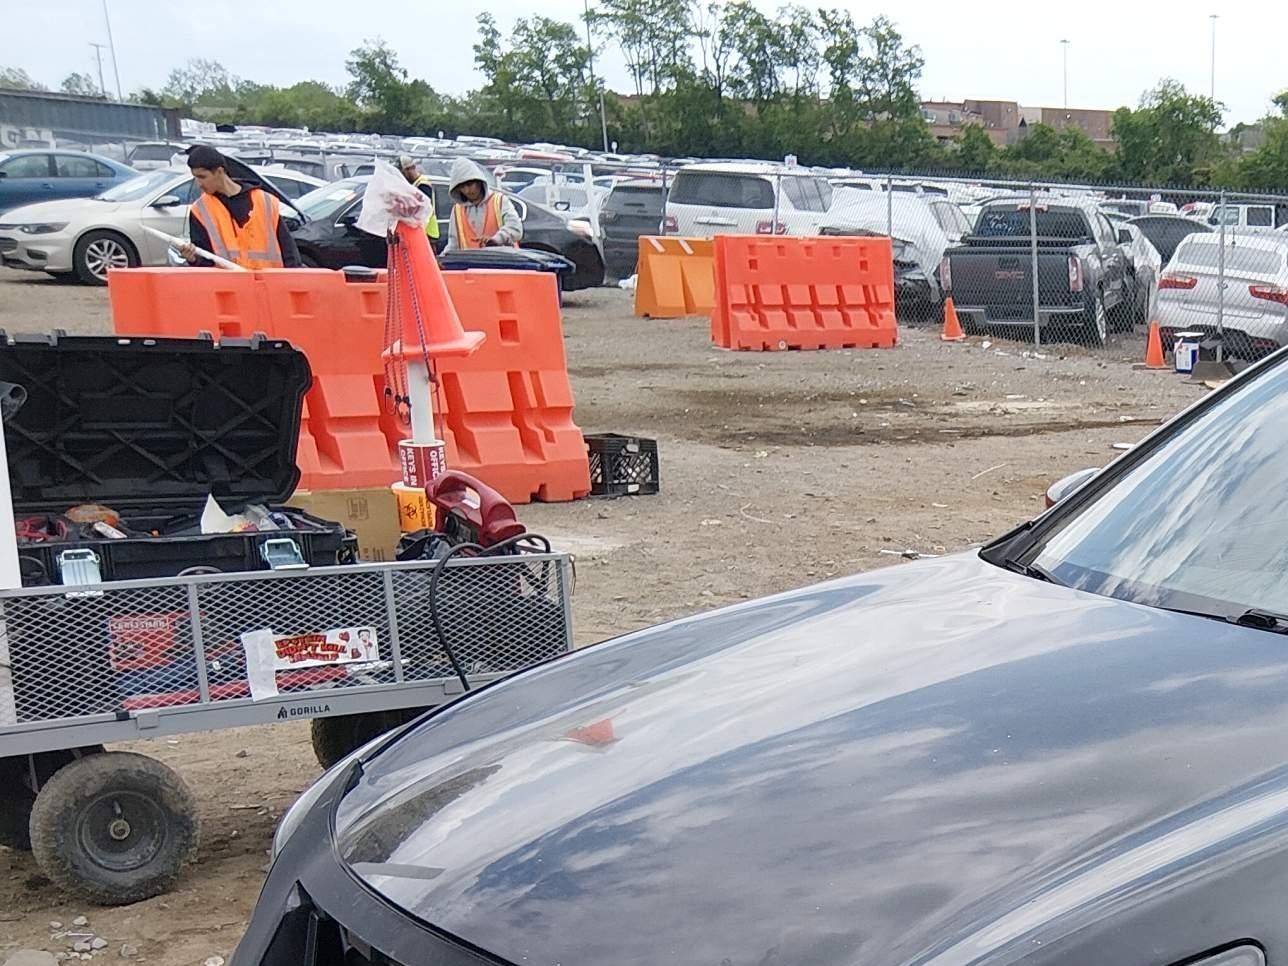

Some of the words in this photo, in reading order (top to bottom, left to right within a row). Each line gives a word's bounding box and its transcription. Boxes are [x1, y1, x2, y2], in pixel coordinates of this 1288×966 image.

[407, 448, 416, 474] KEYS
[410, 475, 418, 486] IN
[290, 704, 330, 716] GORILLA
